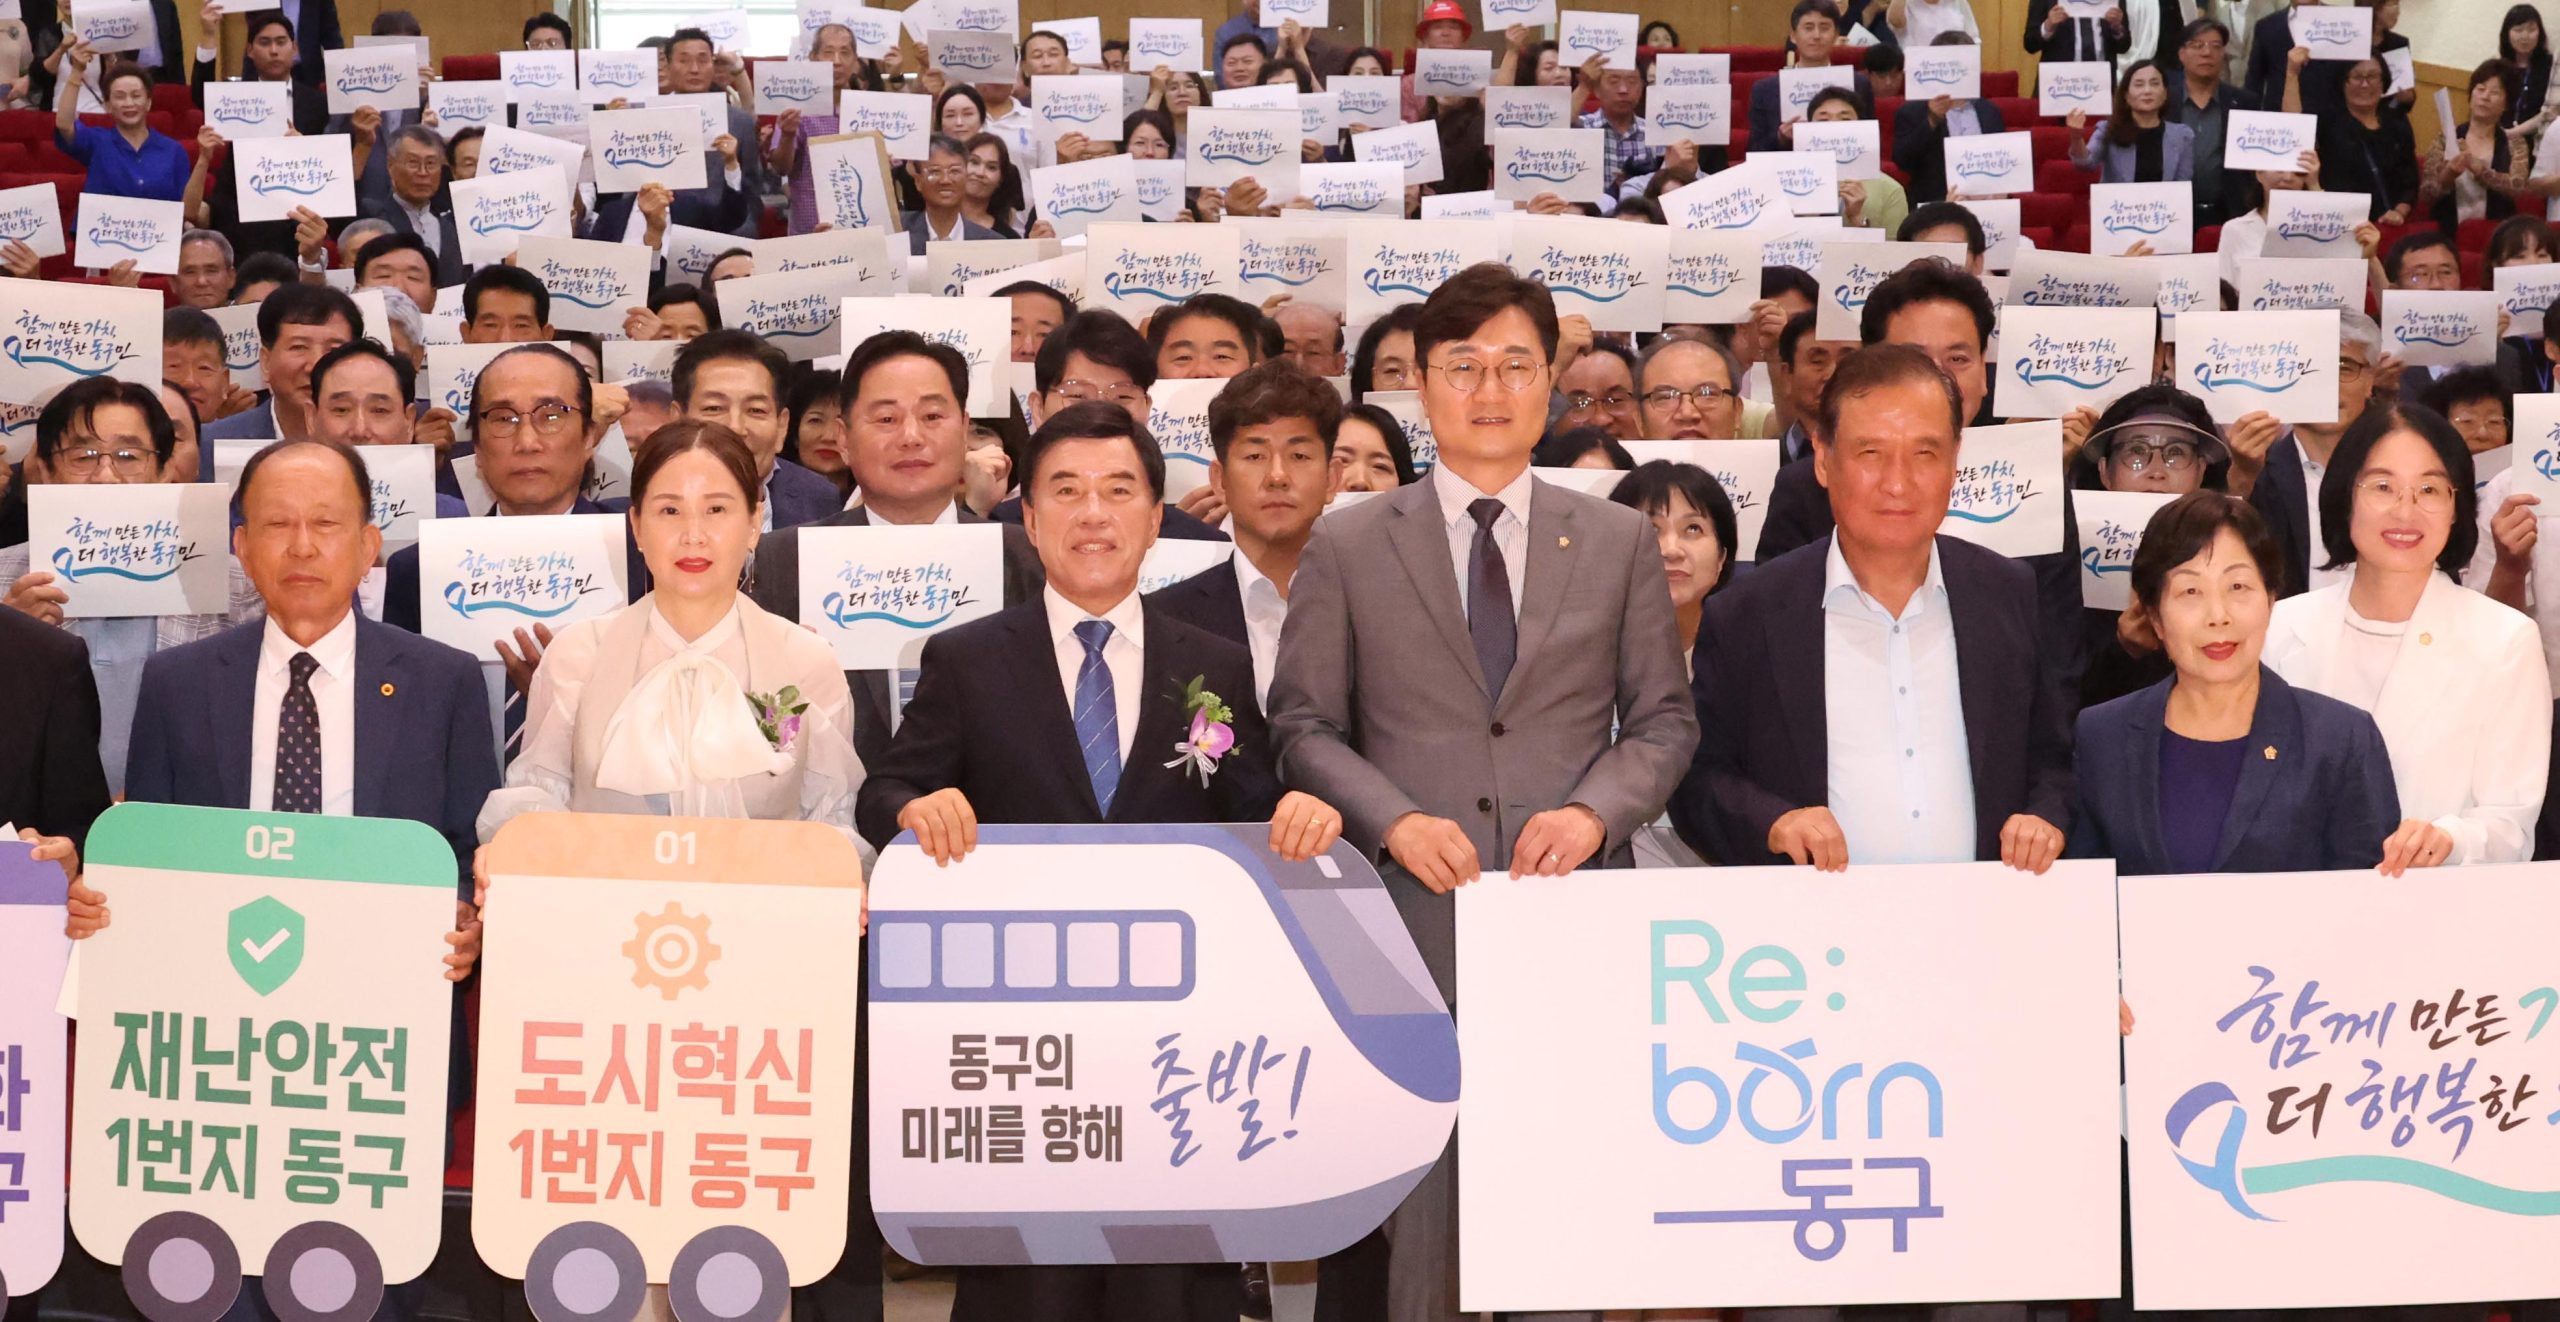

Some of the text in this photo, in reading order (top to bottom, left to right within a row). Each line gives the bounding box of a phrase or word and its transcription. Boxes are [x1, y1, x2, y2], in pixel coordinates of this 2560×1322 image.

[541, 258, 572, 277] 함께
[573, 266, 591, 278] 만든
[1115, 248, 1151, 270] 함께
[1152, 254, 1173, 268] 만든
[1374, 245, 1409, 266] 함께
[1411, 250, 1431, 264] 만든
[1540, 245, 1577, 268] 함께
[1578, 253, 1599, 267] 만든
[547, 276, 633, 300] 더 행복한 동구민
[1123, 267, 1222, 291] 더 행복한 동구민
[1382, 268, 1397, 281] 더
[1398, 264, 1436, 286] 행복한
[1548, 266, 1649, 291] 더 행복한 동구민
[746, 301, 779, 319] 함께
[780, 299, 800, 312] 만든
[757, 304, 842, 330] 더 행복한 동구민
[15, 309, 116, 339] 함께 만든 가치,
[25, 333, 140, 364] 더 행복한 동구민
[2028, 333, 2116, 356] 함께 만든 가치,
[2205, 337, 2243, 360] 함께
[2245, 342, 2267, 357] 만든
[2035, 353, 2136, 378] 더 행복한 동구민
[2214, 355, 2321, 381] 더 행복한 동구민
[1990, 479, 2043, 507] 동구민
[66, 518, 179, 545] 함께 만든 가치,
[2096, 520, 2137, 545] 함께
[77, 538, 207, 568] 더 행복한 동구민
[457, 549, 574, 578] 함께 만든 가치,
[2105, 548, 2121, 561] 더
[470, 570, 604, 603] 더 행복한 동구민
[836, 560, 951, 589] 함께 만든 가치,
[848, 582, 980, 614] 더 행복한 동구민
[246, 825, 295, 861] 02
[655, 831, 696, 865] 01
[1651, 920, 1847, 1024] Re:
[2216, 966, 2511, 1070] 함께 만든
[112, 1011, 408, 1116] 재난안전
[515, 1021, 813, 1116] 도시혁신
[950, 1034, 1074, 1091] 동구의
[1150, 1033, 1311, 1167] 출발!
[1652, 1038, 1944, 1145] born
[2267, 1058, 2539, 1163] 더 행복한
[902, 1105, 1123, 1163] 미래를 향해
[105, 1118, 258, 1199] 1번지
[284, 1128, 408, 1209] 동구
[509, 1129, 815, 1211] 1번지 동구
[1654, 1157, 1944, 1261] 동구
